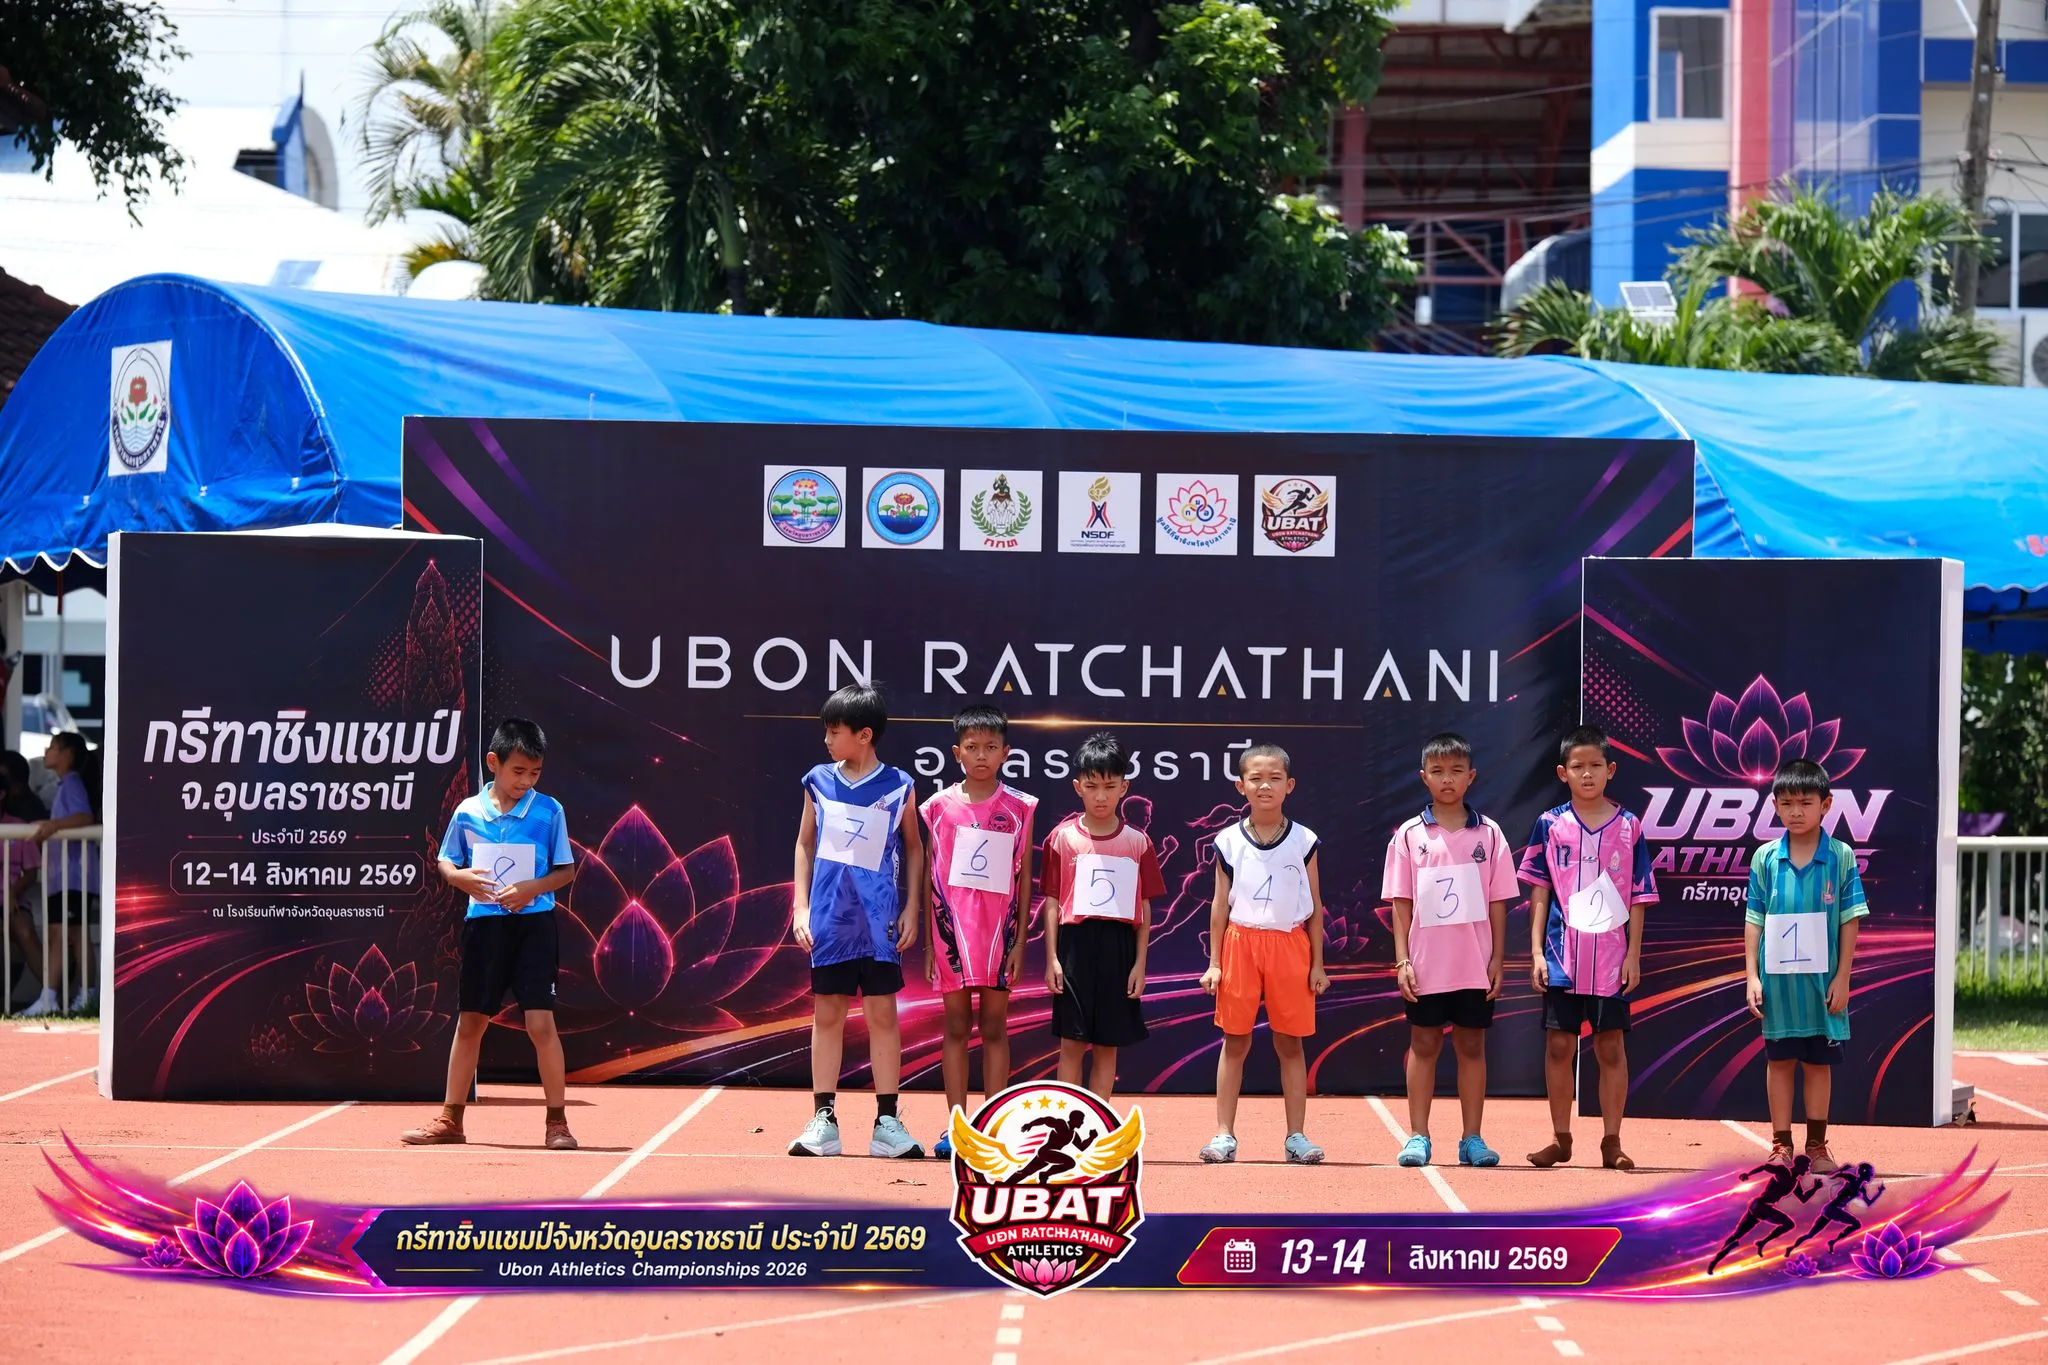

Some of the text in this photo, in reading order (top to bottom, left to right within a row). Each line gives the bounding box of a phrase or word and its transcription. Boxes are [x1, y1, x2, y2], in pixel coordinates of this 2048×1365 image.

[1081, 531, 1115, 539] NSDF
[1266, 516, 1323, 532] UBAT
[984, 537, 1019, 549] กกท
[611, 635, 1498, 702] UBON RATCHATHANI
[143, 706, 462, 765] กรีฑาชิงแชมป์
[181, 771, 415, 822] จ.อุบลราชธานี
[251, 828, 347, 846] ประจำปี 2569
[844, 817, 869, 848] 7
[266, 861, 351, 887] สิงหาคม
[360, 864, 417, 887] 2569
[968, 838, 990, 875] 6
[1089, 868, 1116, 907] 5
[1252, 874, 1273, 914] 4
[1435, 877, 1460, 919] 3
[212, 903, 385, 921] ณ โรงเรียนกีฬาจังหวัดอุบลราชธานี
[1587, 889, 1614, 927] 2
[1779, 921, 1812, 964] 1
